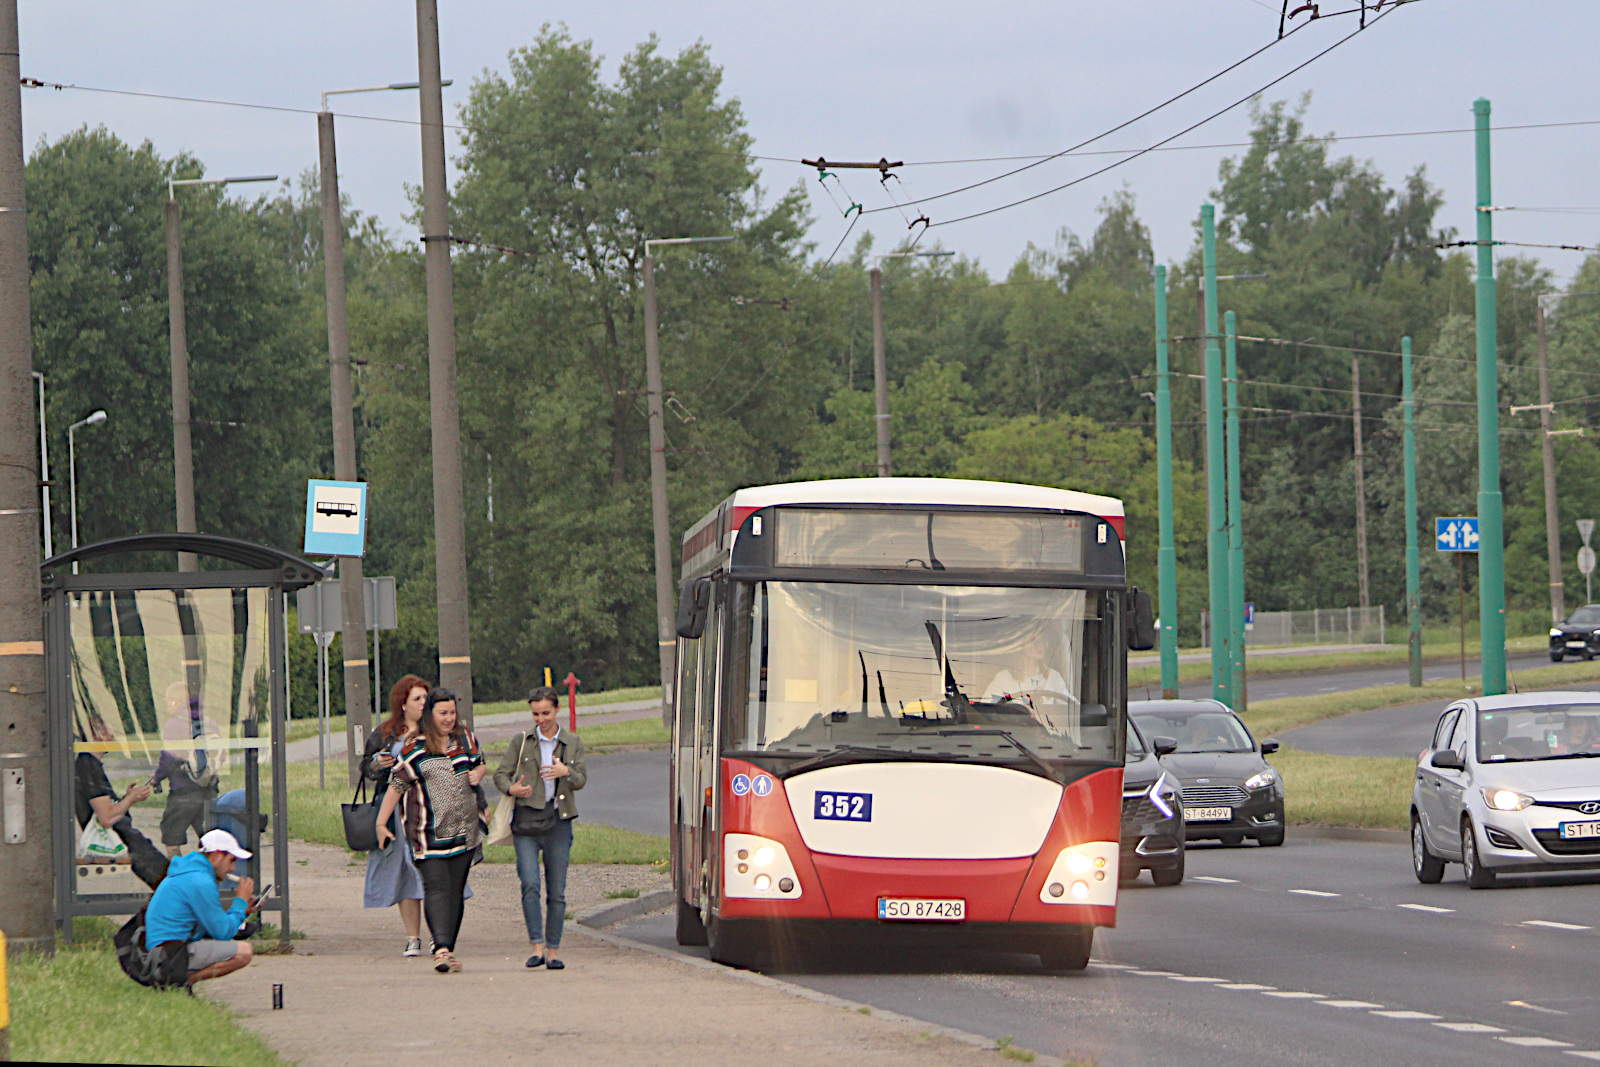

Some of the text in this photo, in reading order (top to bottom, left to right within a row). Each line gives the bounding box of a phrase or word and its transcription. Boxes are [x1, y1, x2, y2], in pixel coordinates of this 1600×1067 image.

[820, 794, 864, 818] 352
[1185, 809, 1197, 818] ST
[1567, 824, 1583, 836] ST
[888, 901, 962, 917] SO 87428
